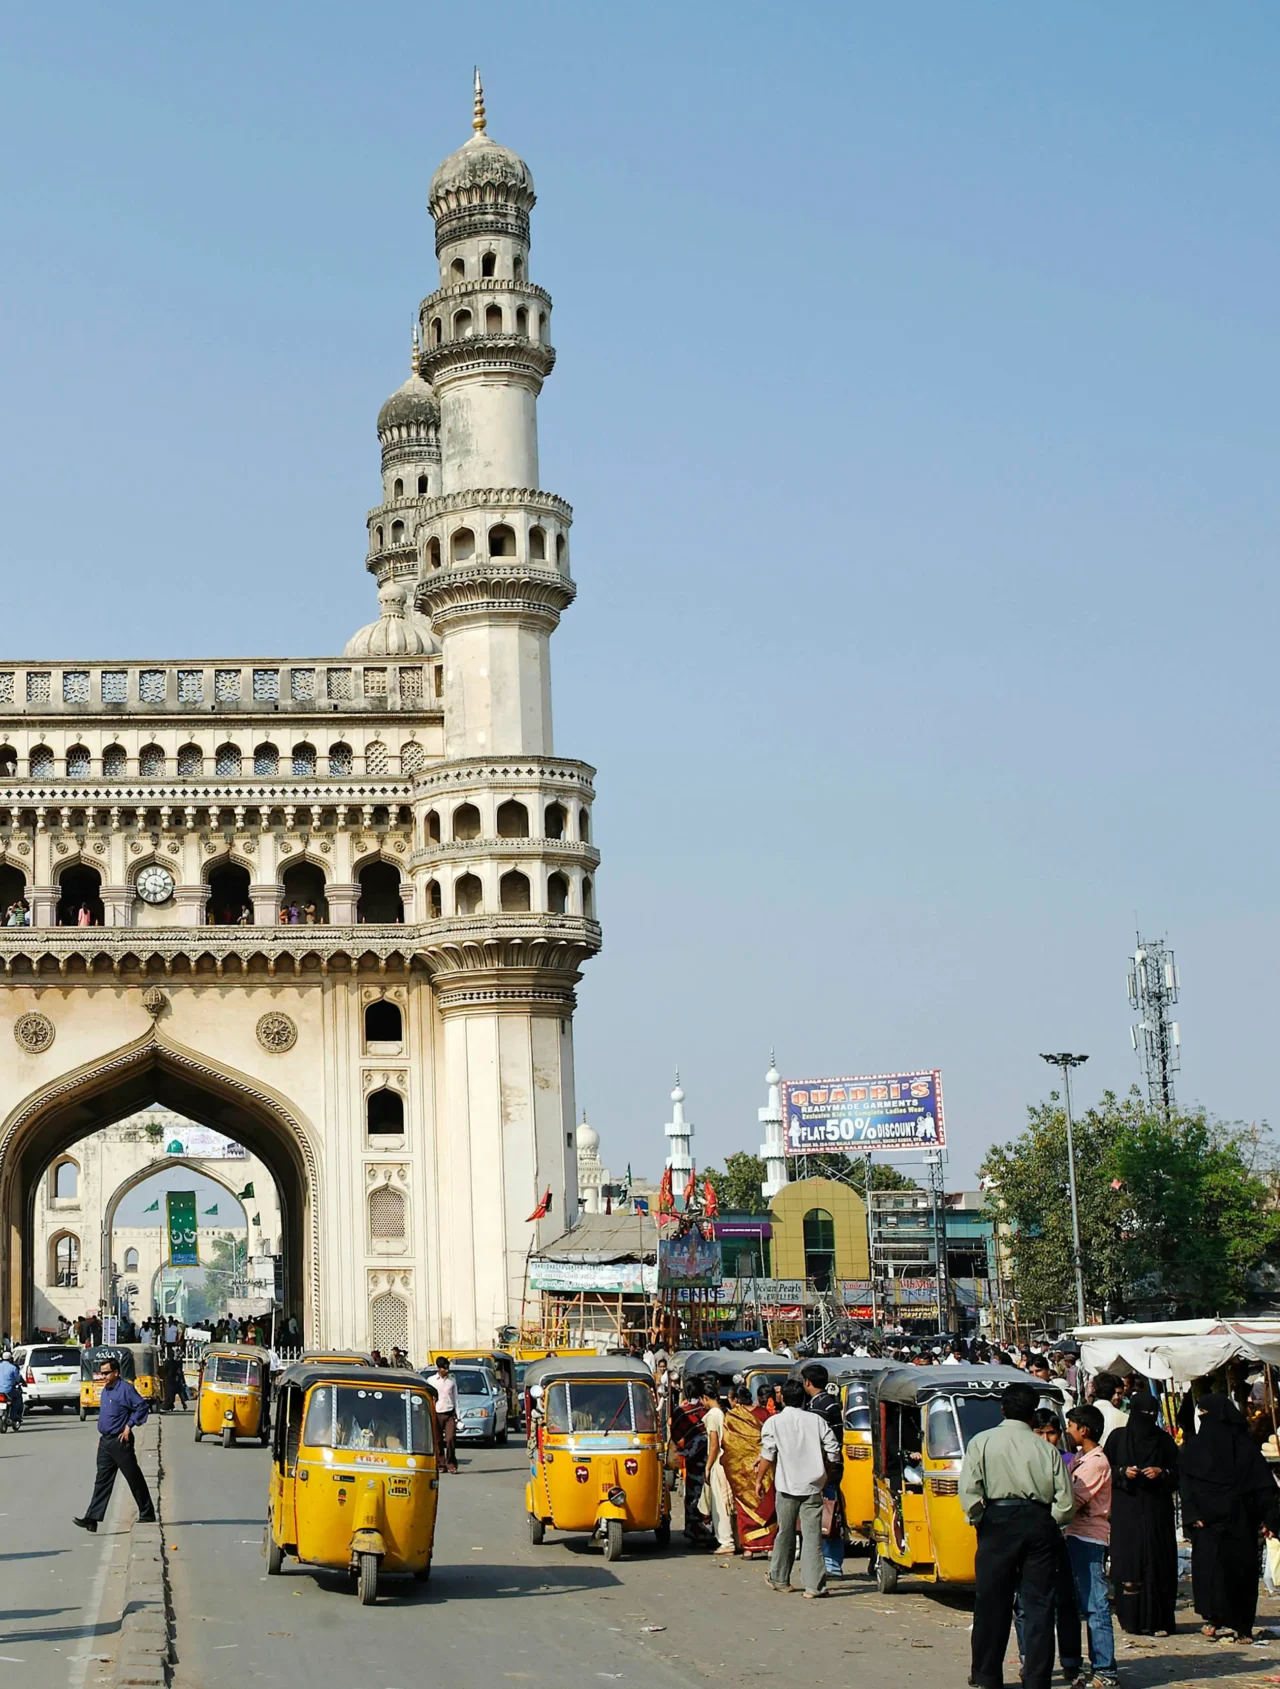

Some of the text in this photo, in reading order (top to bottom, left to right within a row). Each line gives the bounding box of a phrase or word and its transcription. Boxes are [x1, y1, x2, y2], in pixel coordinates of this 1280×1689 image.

[791, 1082, 930, 1107] QUADRI'S
[801, 1099, 918, 1113] READYMADE GARMENTS
[802, 1117, 916, 1141] FLAT 50% DISCOUNT
[778, 1284, 802, 1292] Pearls
[968, 1381, 978, 1389] M
